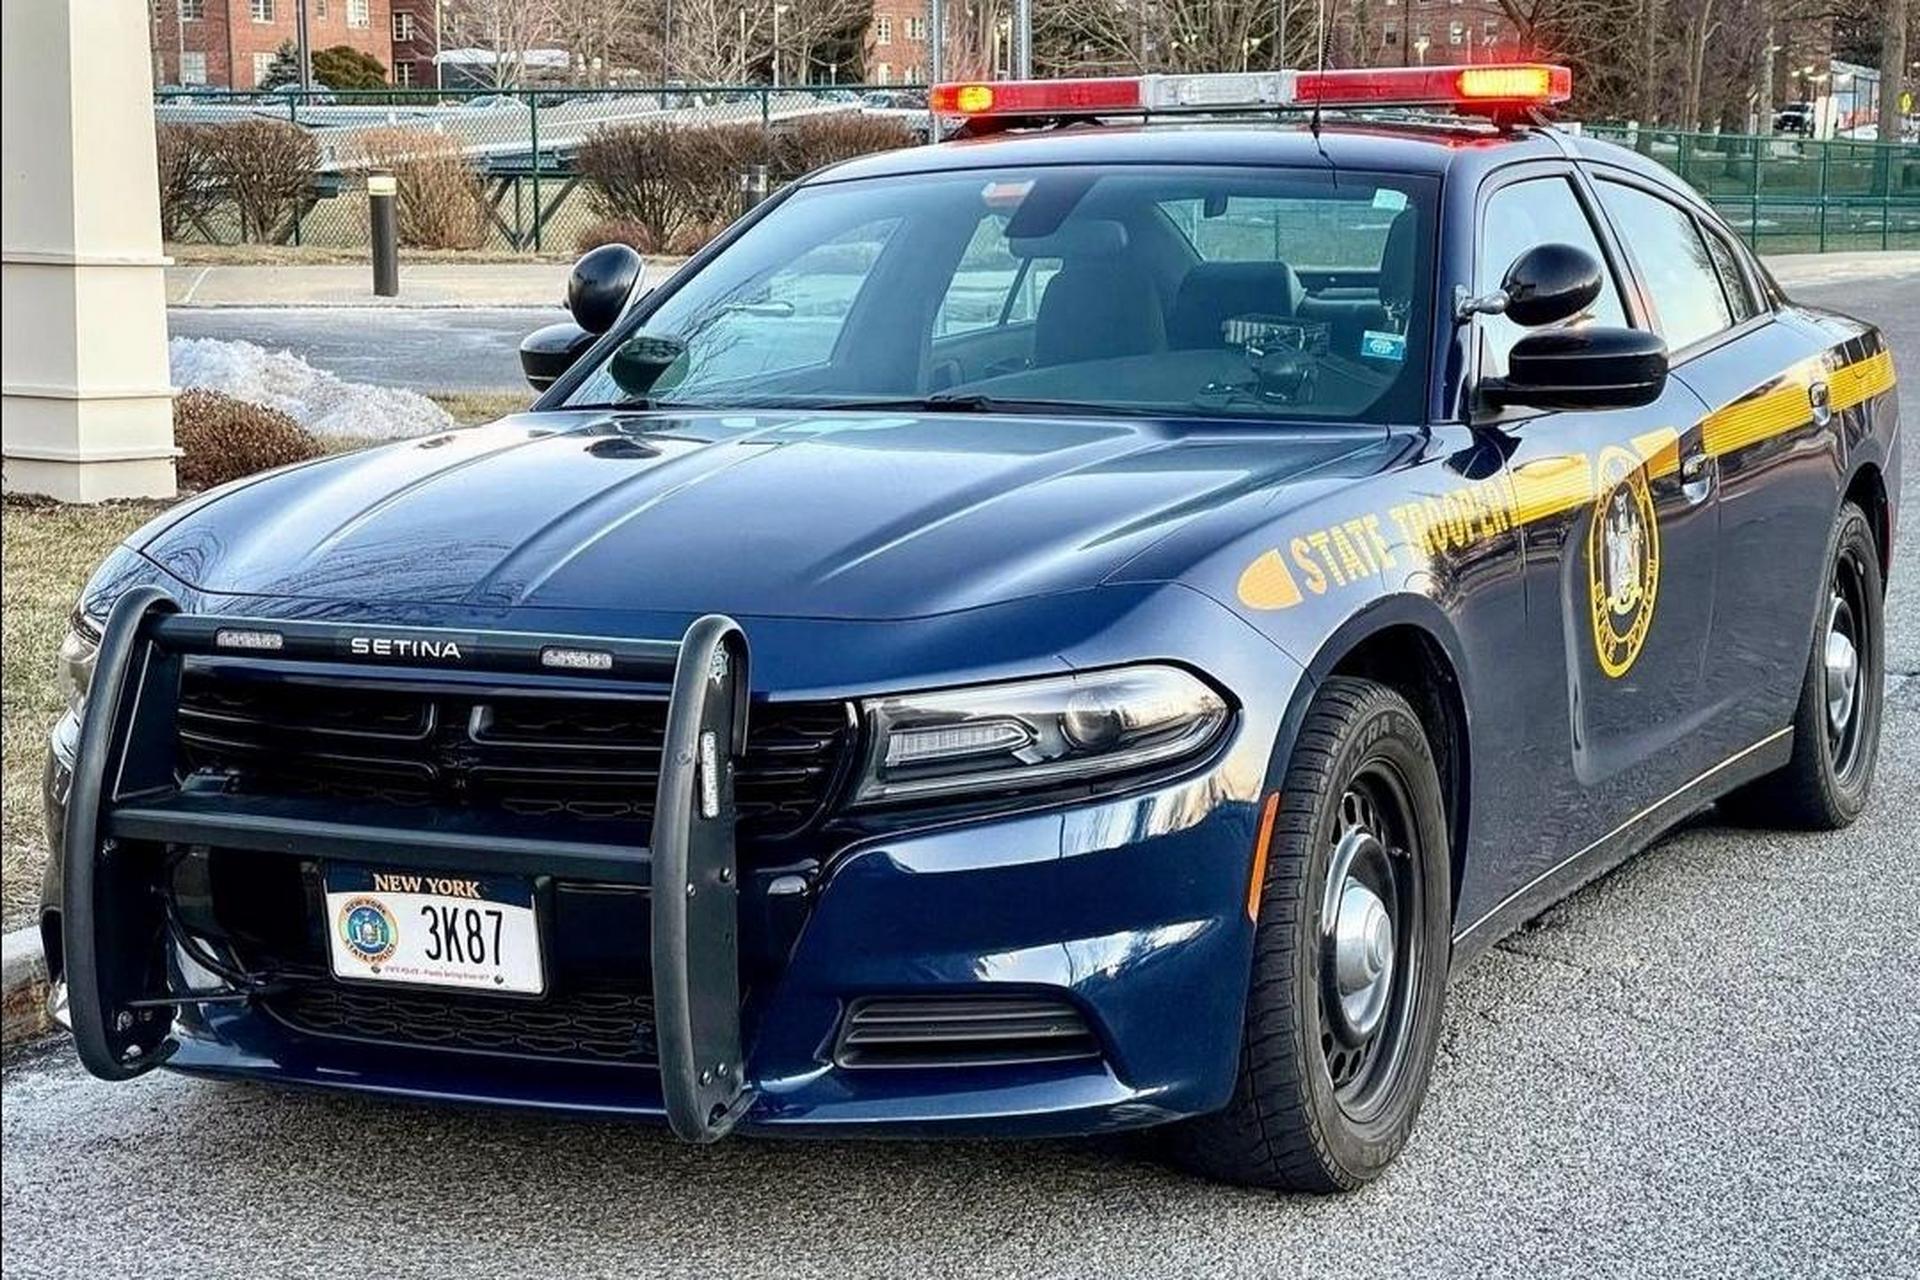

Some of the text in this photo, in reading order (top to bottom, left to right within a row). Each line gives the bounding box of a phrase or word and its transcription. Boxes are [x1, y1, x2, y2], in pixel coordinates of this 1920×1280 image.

[1290, 513, 1396, 595] STATE
[1389, 480, 1510, 560] TROOPER
[351, 637, 462, 659] SETINA
[373, 873, 482, 899] NEW YORK
[420, 904, 504, 967] 3K87
